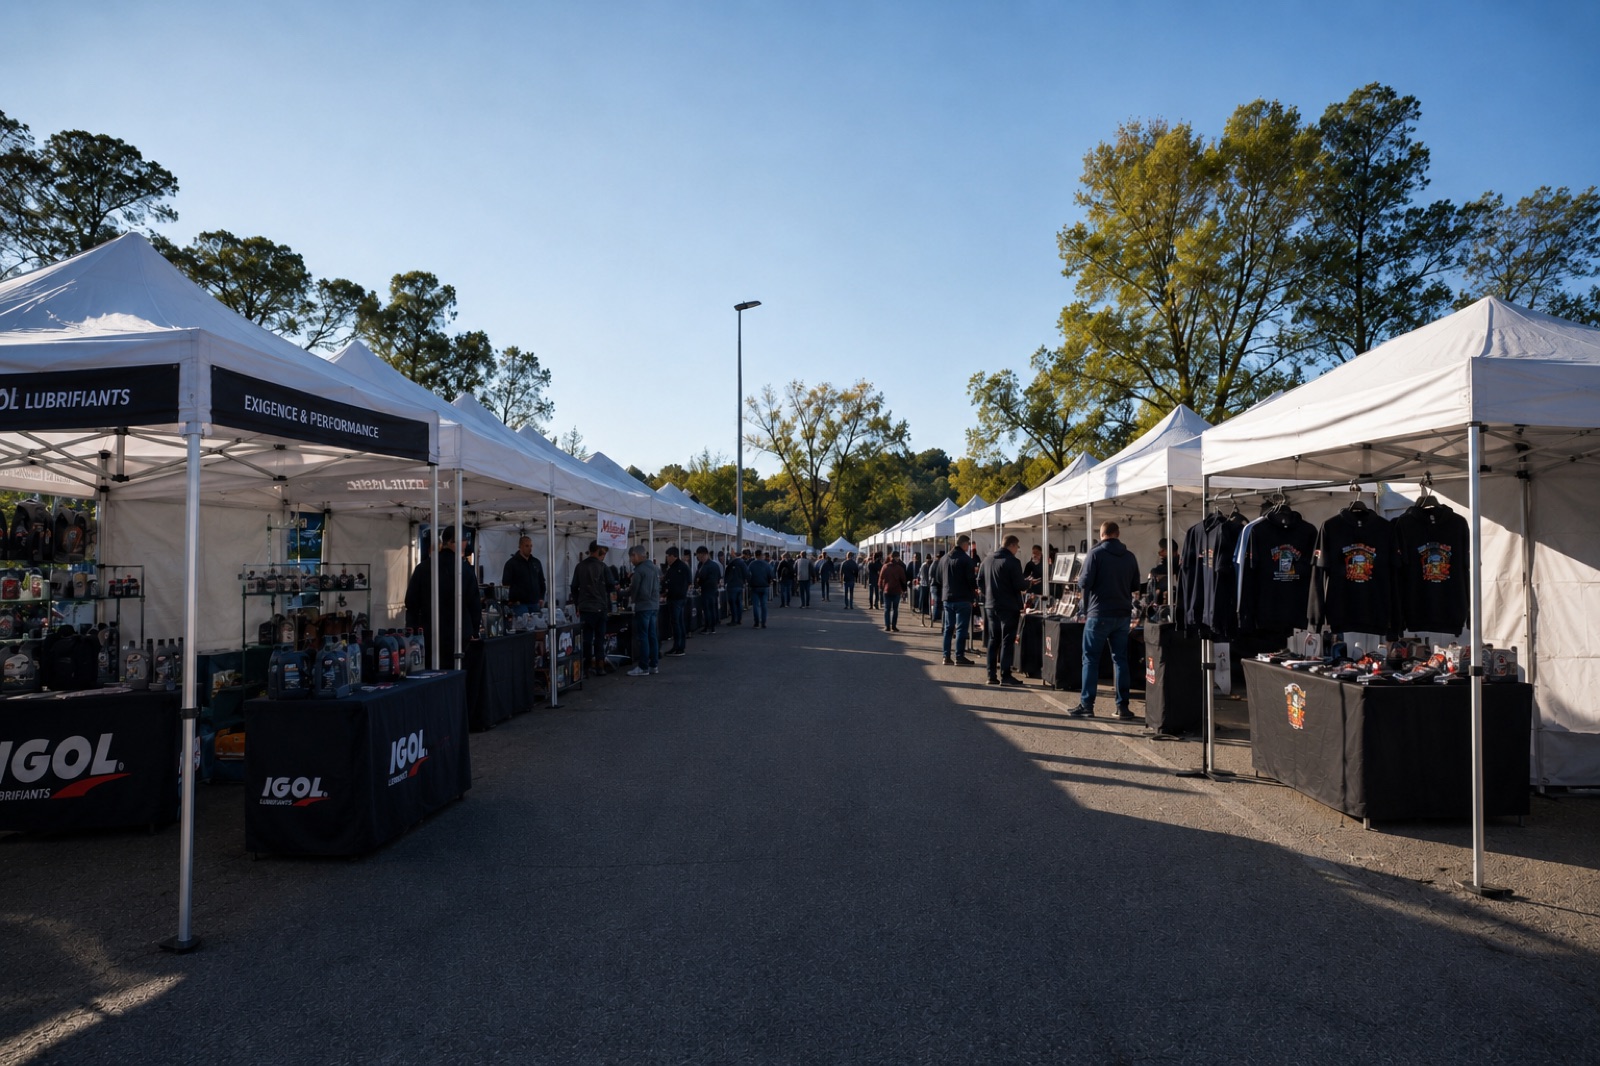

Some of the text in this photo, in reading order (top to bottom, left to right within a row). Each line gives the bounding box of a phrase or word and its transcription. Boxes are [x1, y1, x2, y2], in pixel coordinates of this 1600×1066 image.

[24, 388, 131, 410] LUBRIFIANTS
[244, 394, 379, 438] EXIGENCE & PERFORMANCE
[390, 729, 426, 775] IGOL
[262, 776, 324, 798] IGOL
